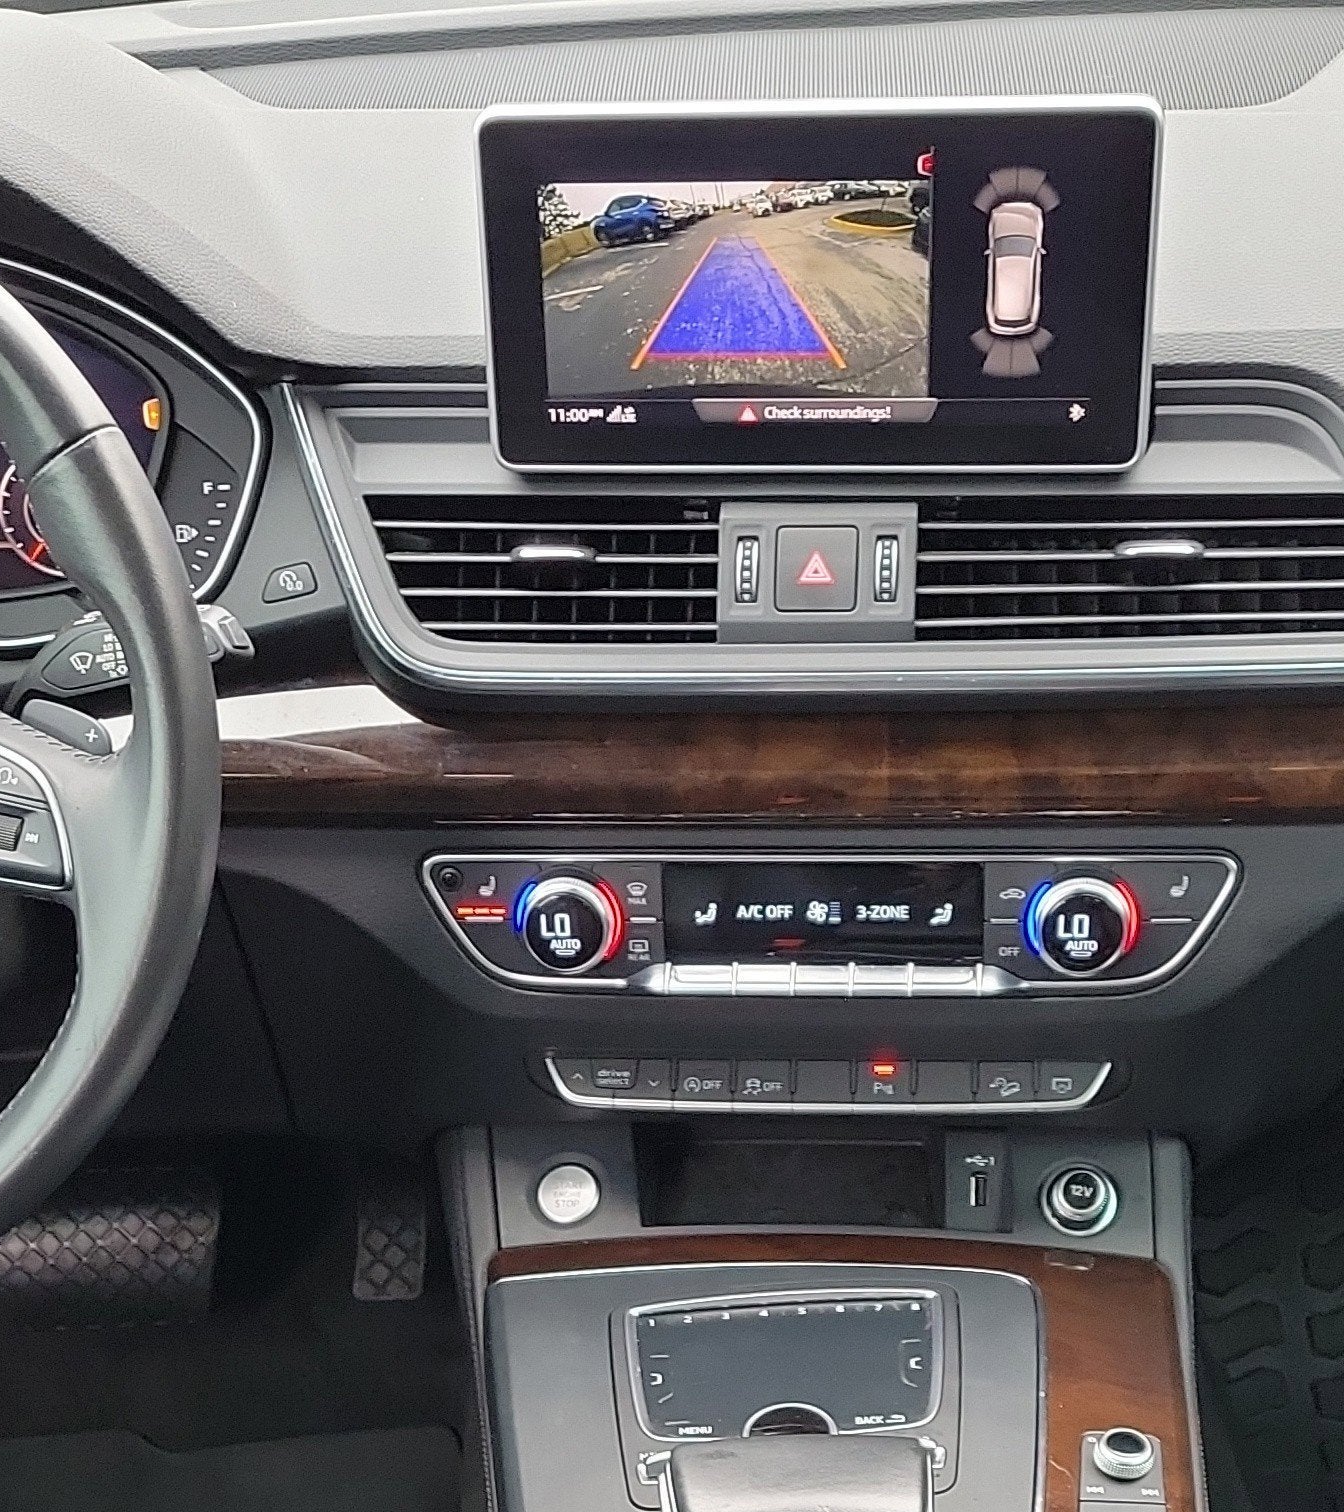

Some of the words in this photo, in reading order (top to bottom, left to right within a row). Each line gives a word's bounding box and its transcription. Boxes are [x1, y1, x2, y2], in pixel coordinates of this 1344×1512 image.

[764, 405, 803, 419] Check
[803, 405, 892, 422] surroundings!
[202, 481, 215, 494] F
[735, 904, 764, 919] A/C
[765, 903, 794, 919] OFF
[856, 904, 910, 920] 3-ZONE
[539, 913, 572, 938] LO
[1058, 914, 1090, 938] LO
[549, 938, 582, 951] AUTO
[1065, 940, 1099, 952] AUTO
[998, 946, 1021, 958] OFF
[597, 1068, 632, 1078] drive
[702, 1079, 723, 1091] OFF
[762, 1082, 784, 1093] OFF
[1069, 1184, 1094, 1198] 12V
[554, 1199, 580, 1208] STOP
[683, 1315, 693, 1323] 2
[721, 1311, 731, 1320] 3
[758, 1308, 769, 1317] 4
[797, 1306, 808, 1315] 5
[874, 1303, 884, 1312] 7
[854, 1415, 884, 1425] BACK
[678, 1426, 713, 1436] MENU
